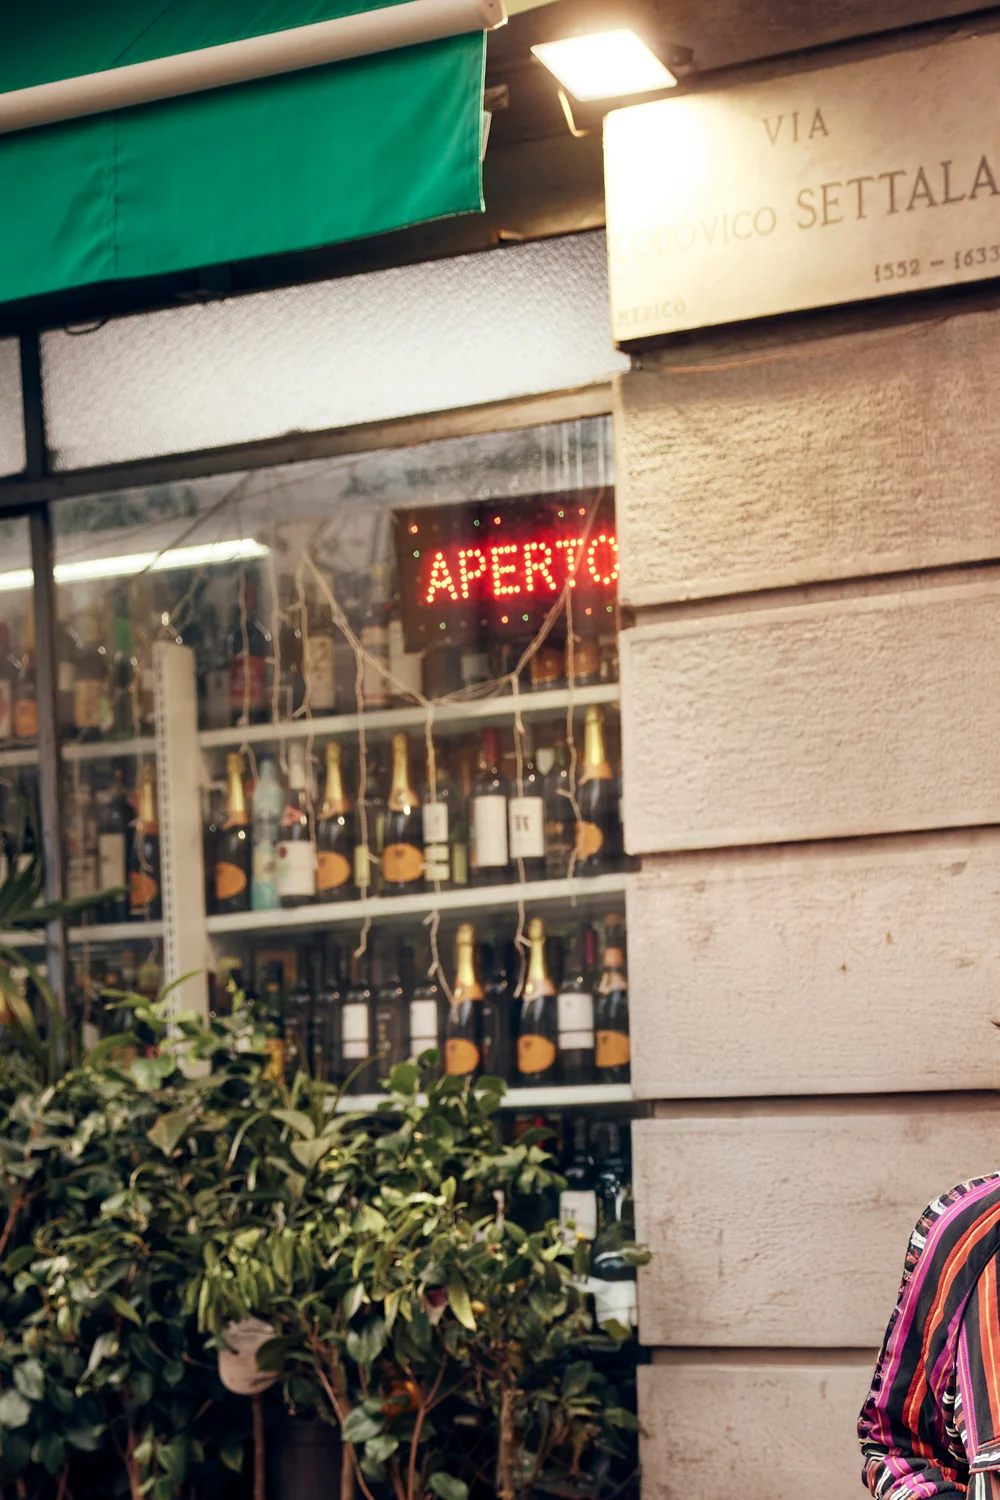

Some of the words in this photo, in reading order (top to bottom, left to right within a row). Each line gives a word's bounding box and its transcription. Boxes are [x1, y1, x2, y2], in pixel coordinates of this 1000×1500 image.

[762, 107, 830, 147] VIA
[874, 257, 921, 283] 1552
[953, 243, 1000, 270] 1633
[615, 299, 687, 327] MEDICO
[426, 534, 620, 603] APERTO
